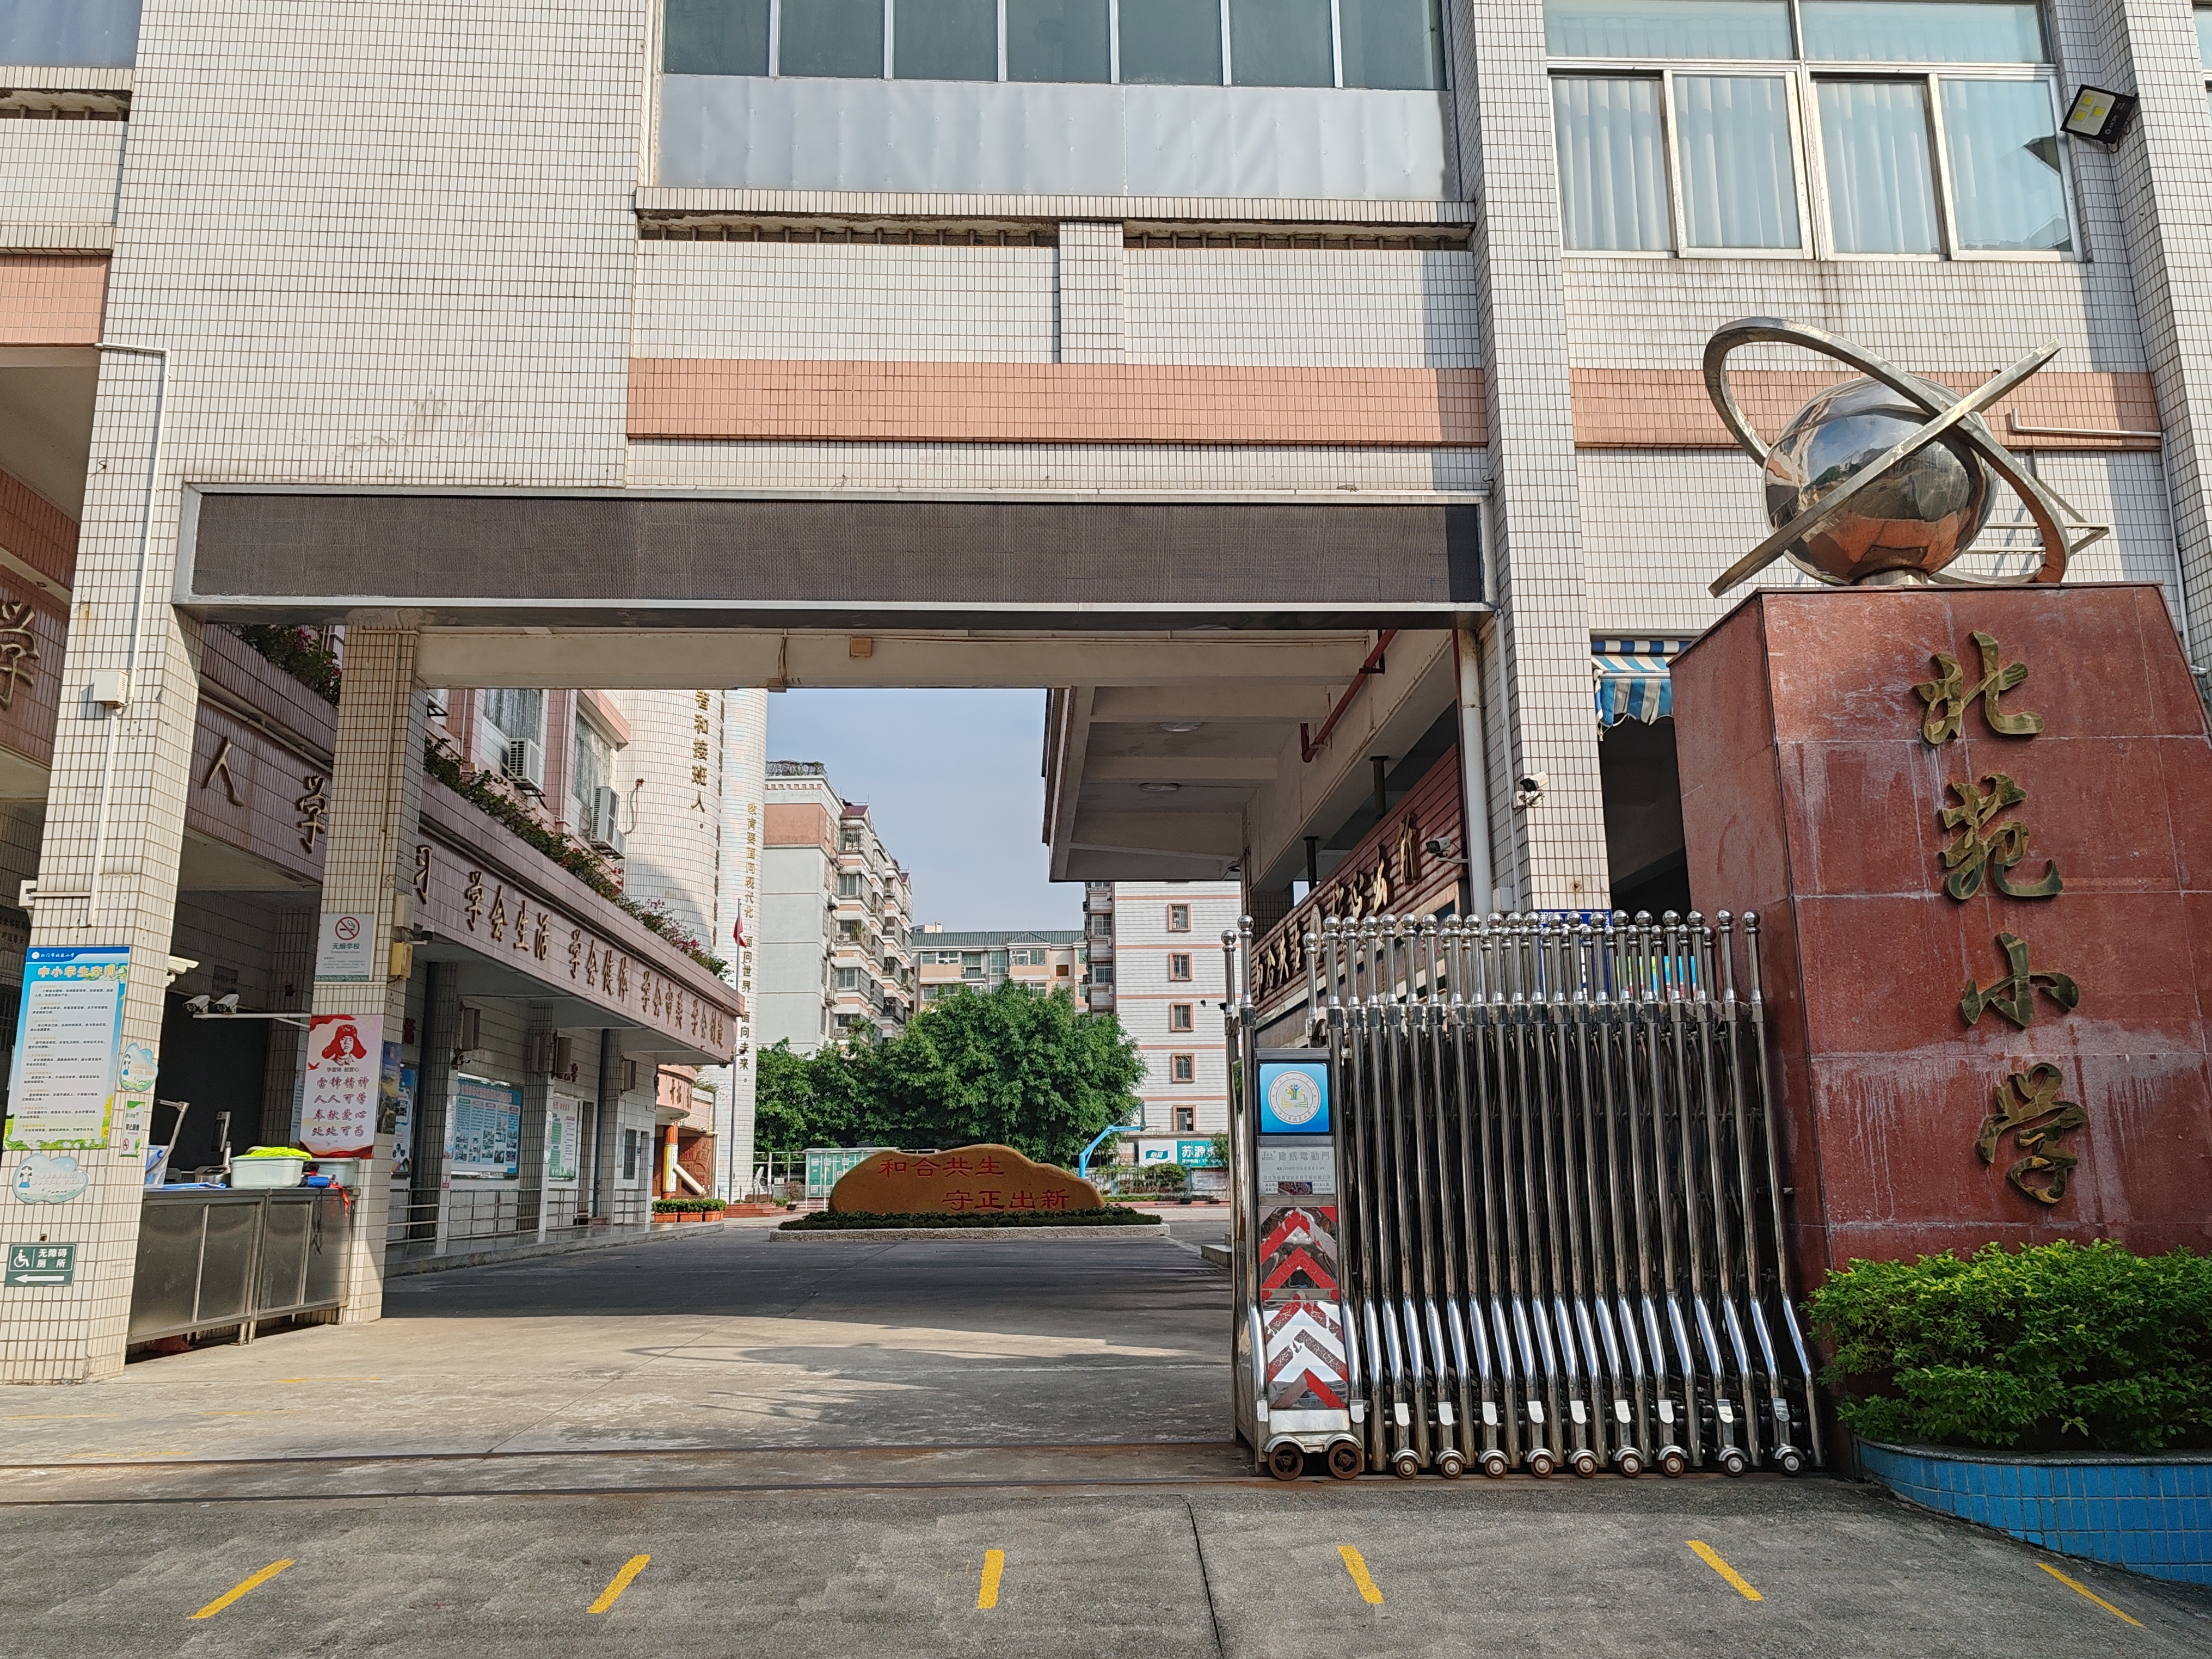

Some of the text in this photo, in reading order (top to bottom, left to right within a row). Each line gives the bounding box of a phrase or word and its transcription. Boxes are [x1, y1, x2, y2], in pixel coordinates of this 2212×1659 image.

[201, 736, 245, 807] 人
[294, 775, 329, 854] 学
[464, 870, 551, 961] 学会生活
[568, 929, 629, 1002] 学会健体
[1913, 629, 2087, 1205] 北苑小学
[38, 964, 116, 978] 中小学生守则
[314, 1092, 367, 1105] 人人可学
[312, 1108, 367, 1122] 奉献爱心
[311, 1125, 365, 1138] 处处可为
[877, 1156, 1005, 1178] 和合共生
[941, 1188, 1070, 1212] 守正出新
[38, 1248, 67, 1258] 无障碍
[36, 1258, 66, 1269] 厕所
